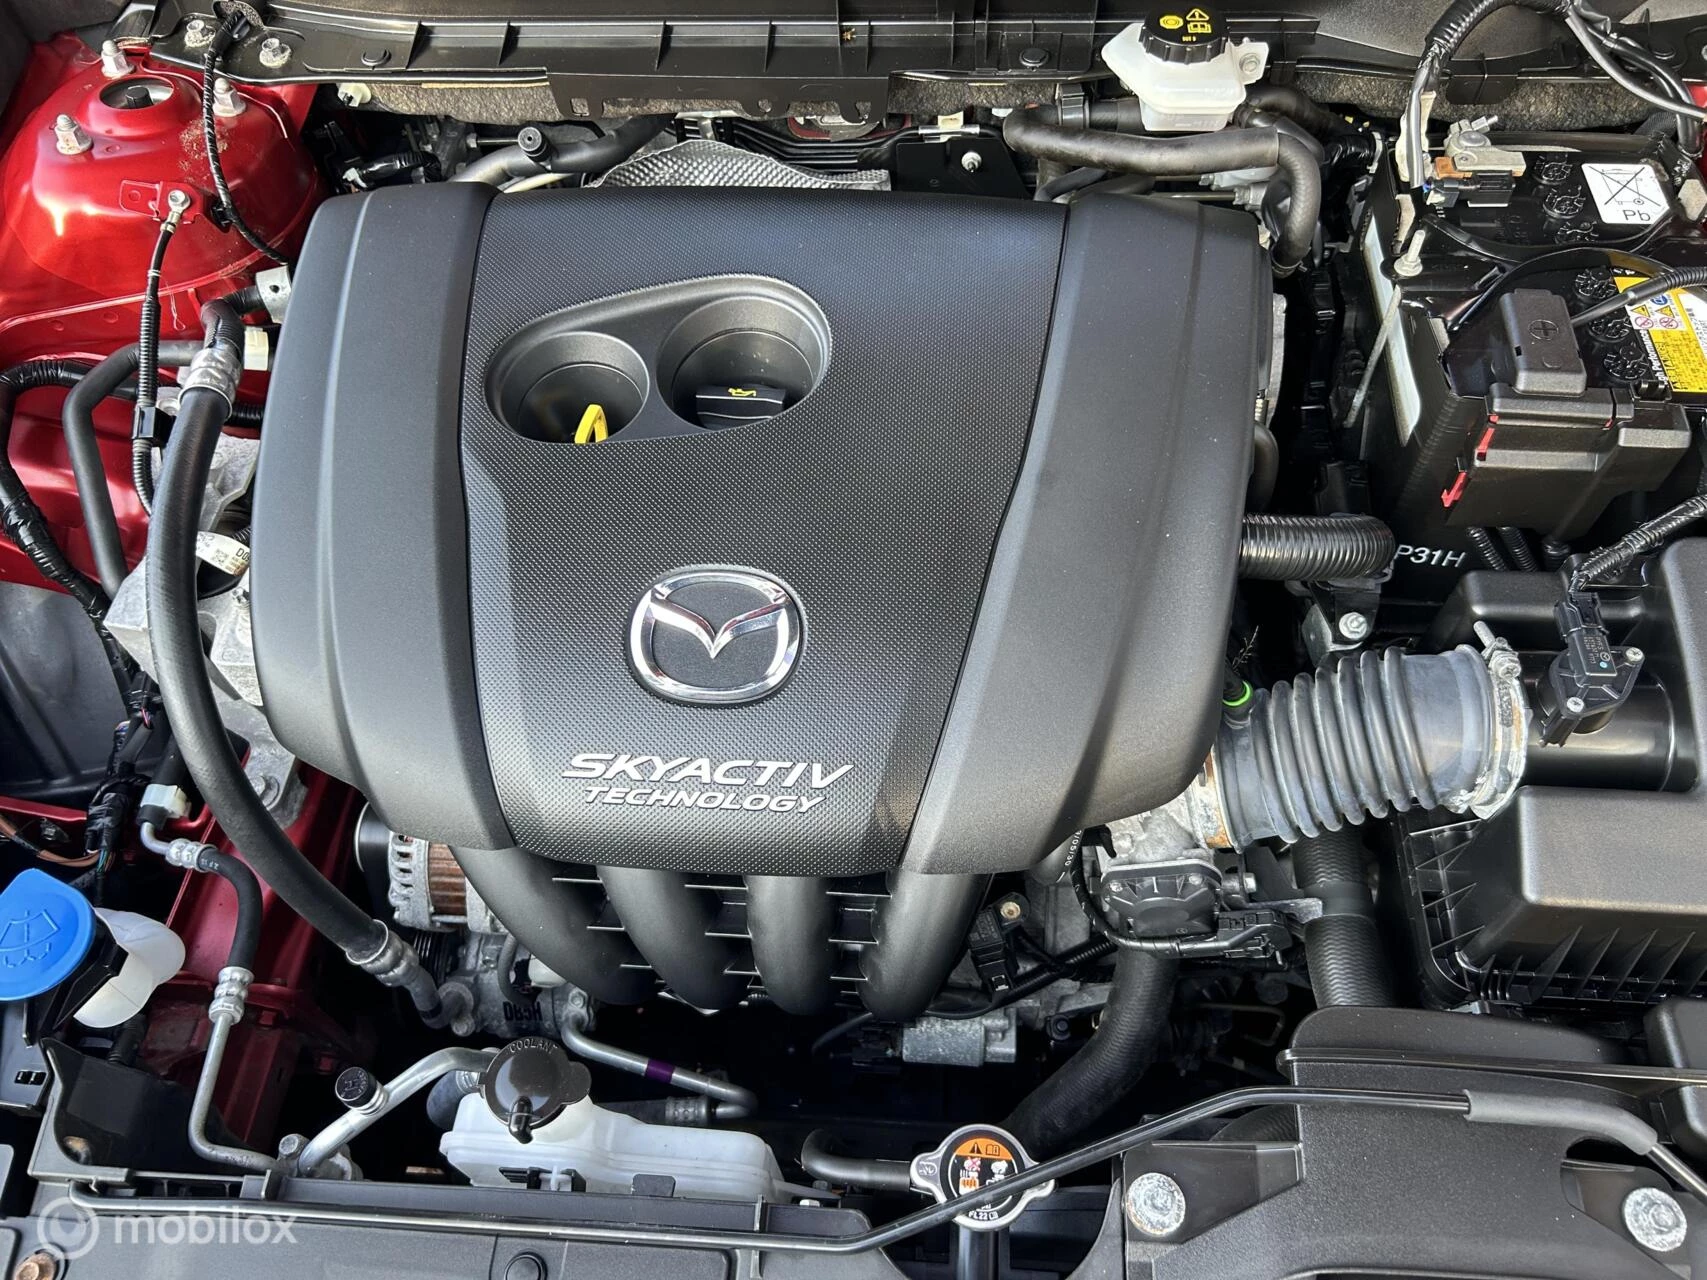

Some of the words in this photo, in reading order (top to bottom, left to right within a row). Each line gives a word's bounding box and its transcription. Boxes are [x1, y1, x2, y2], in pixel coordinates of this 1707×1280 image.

[1622, 209, 1651, 222] Pb
[1393, 544, 1466, 568] P31H
[561, 753, 854, 789] SKYACTIV
[584, 786, 826, 813] TECHNOLOGY
[509, 1038, 558, 1054] COOLANT
